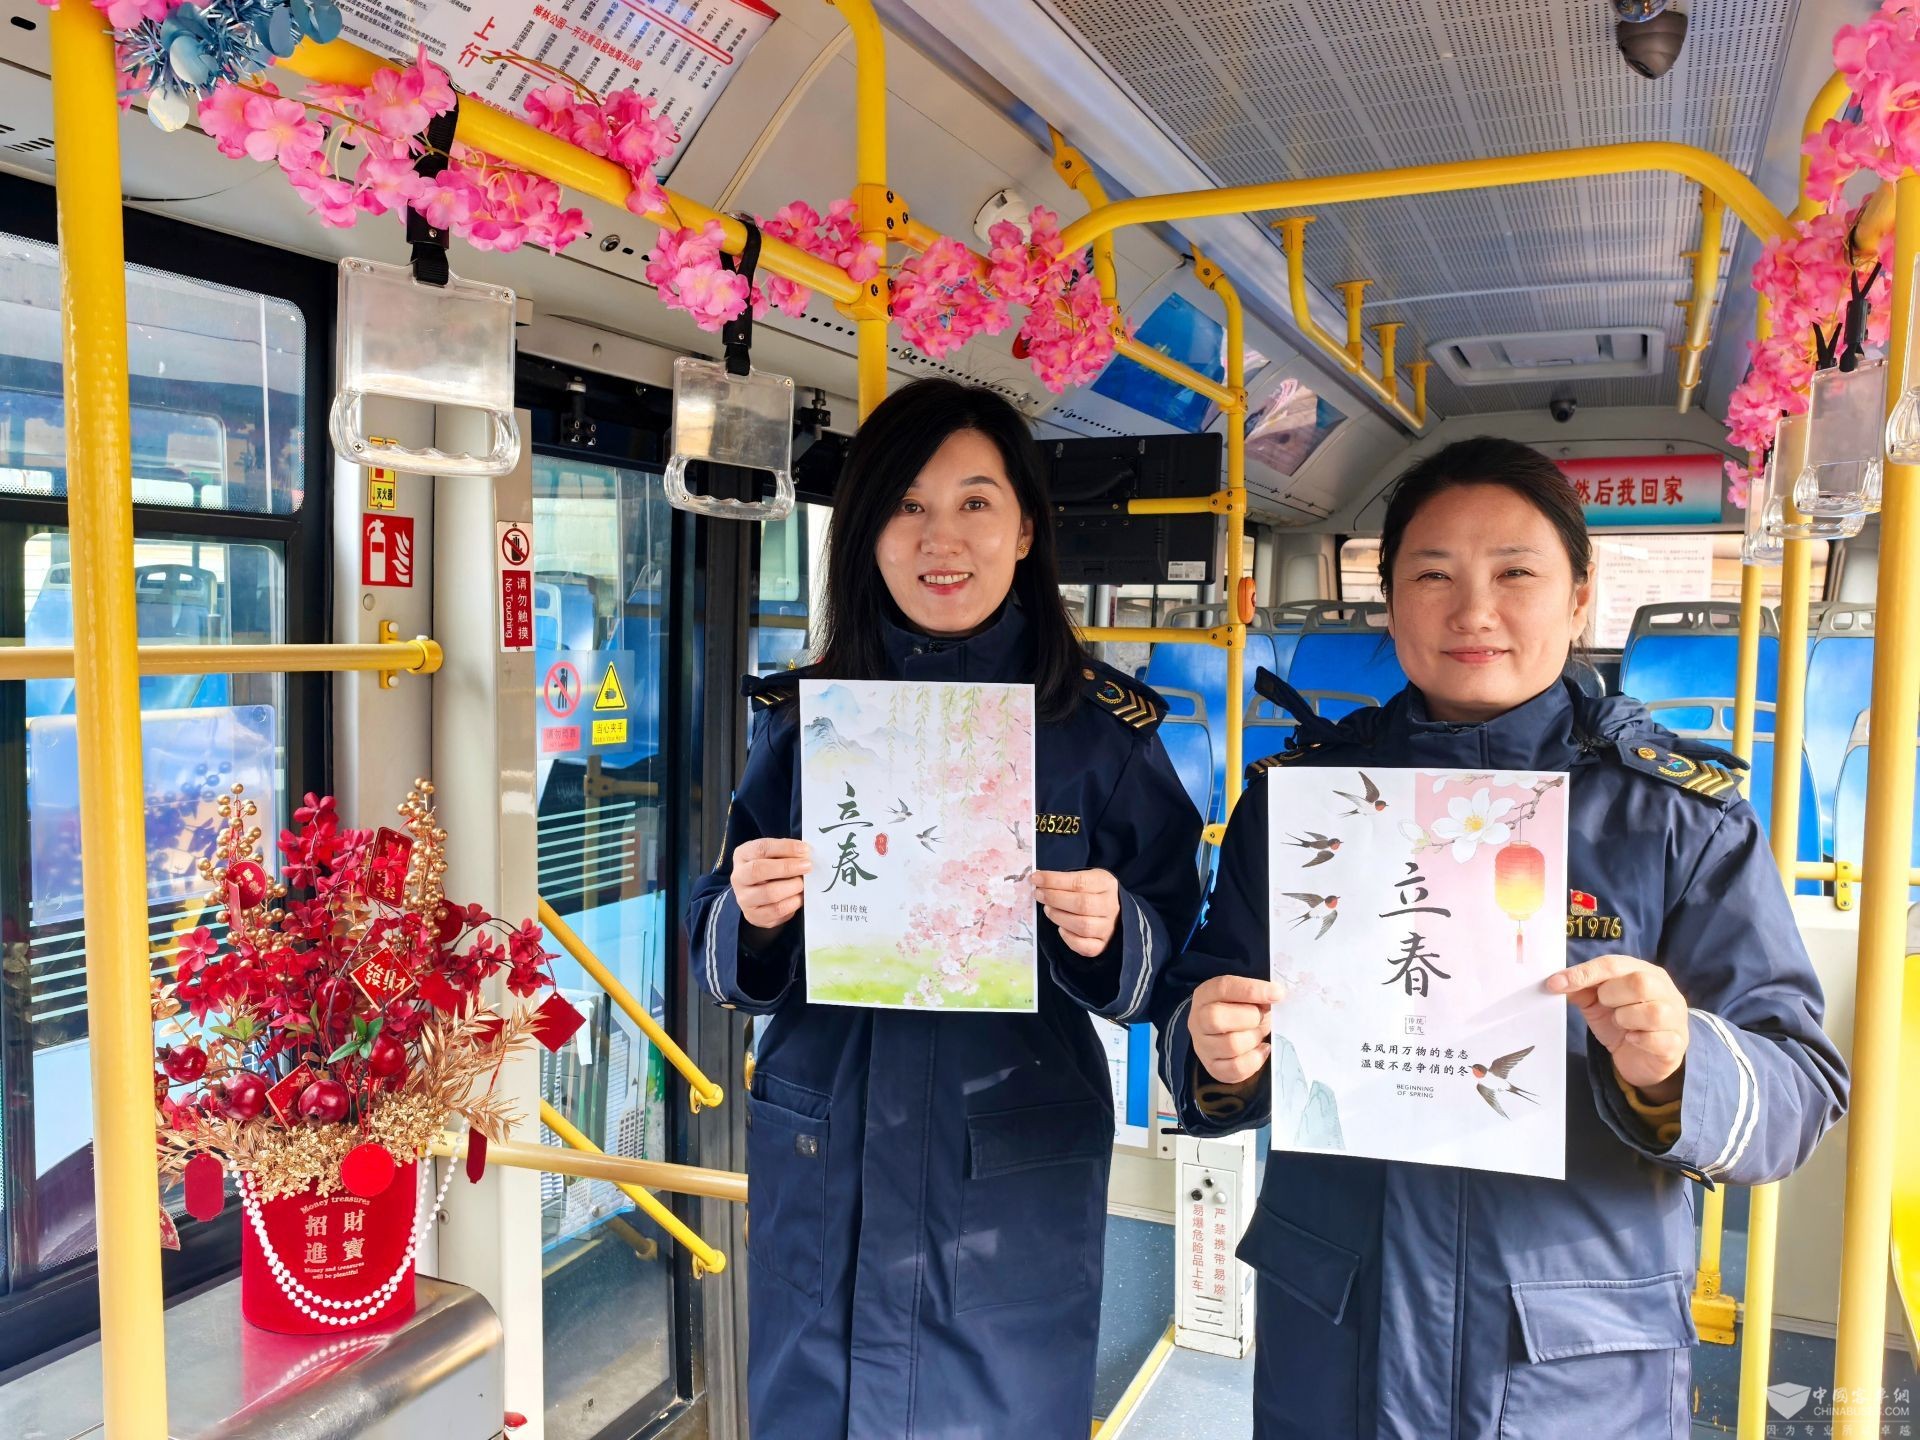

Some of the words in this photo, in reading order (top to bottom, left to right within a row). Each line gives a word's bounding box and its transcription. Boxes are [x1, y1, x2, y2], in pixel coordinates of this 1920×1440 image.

[457, 16, 496, 68] 上行
[376, 487, 393, 501] 灭火器
[1574, 476, 1684, 507] 然后我回家
[505, 577, 513, 593] No
[505, 594, 514, 639] Touching
[517, 576, 529, 640] 请勿触摸
[818, 780, 879, 893] 立春
[831, 903, 868, 914] 中国传统
[831, 914, 868, 923] 二十四节气
[1378, 861, 1452, 998] 立春
[1360, 1042, 1469, 1060] 春风用万物的意志
[1396, 1083, 1435, 1093] BEGINNING
[1409, 1091, 1434, 1099] SPRING
[300, 1198, 329, 1215] Money
[331, 1196, 371, 1206] treasures
[1191, 1203, 1204, 1292] 易爆危险品上车
[1213, 1207, 1227, 1296] 严禁携带易燃
